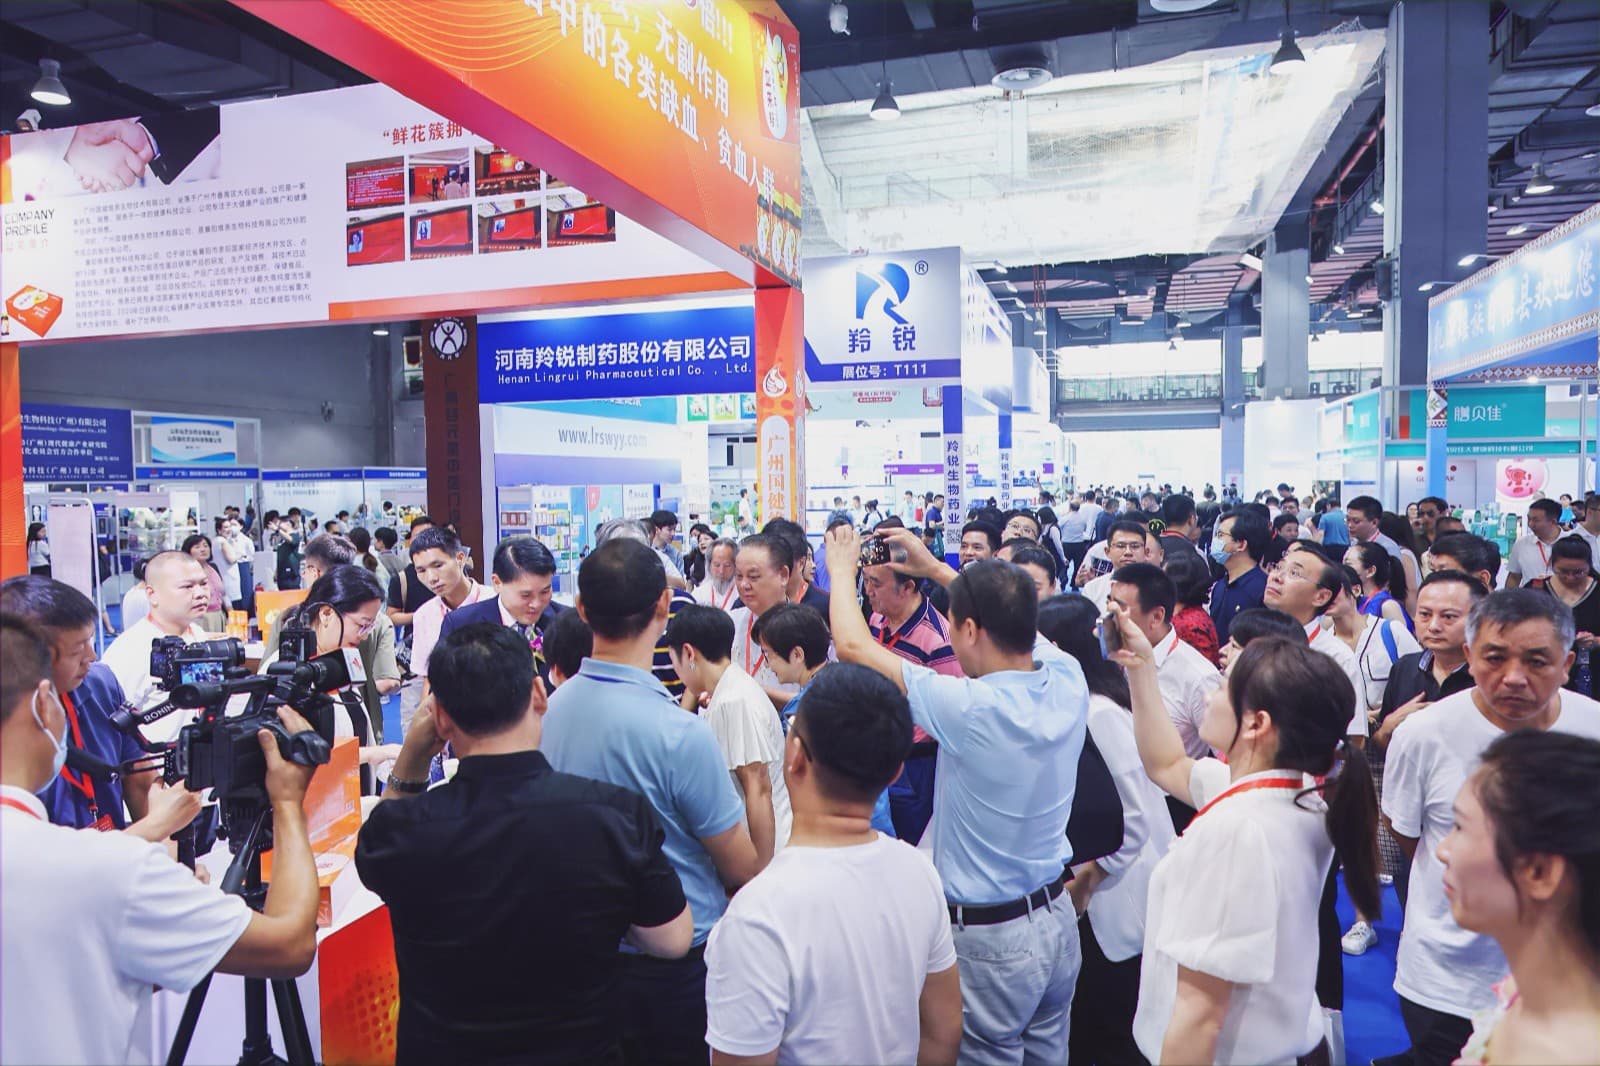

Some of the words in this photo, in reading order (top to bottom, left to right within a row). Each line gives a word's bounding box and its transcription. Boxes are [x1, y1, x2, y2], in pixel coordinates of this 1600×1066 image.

[4, 208, 55, 225] COMPANY
[5, 223, 48, 236] PROFILE
[848, 325, 916, 353] 羚锐
[495, 335, 750, 371] 河南羚锐制药股份有限公司
[498, 374, 530, 385] Henan
[535, 370, 579, 383] Lingrui
[586, 366, 680, 379] Pharmaceutical
[558, 425, 648, 450] www.lrswyy.com
[947, 440, 960, 524] 羚锐生物药业
[143, 703, 175, 722] RONIN
